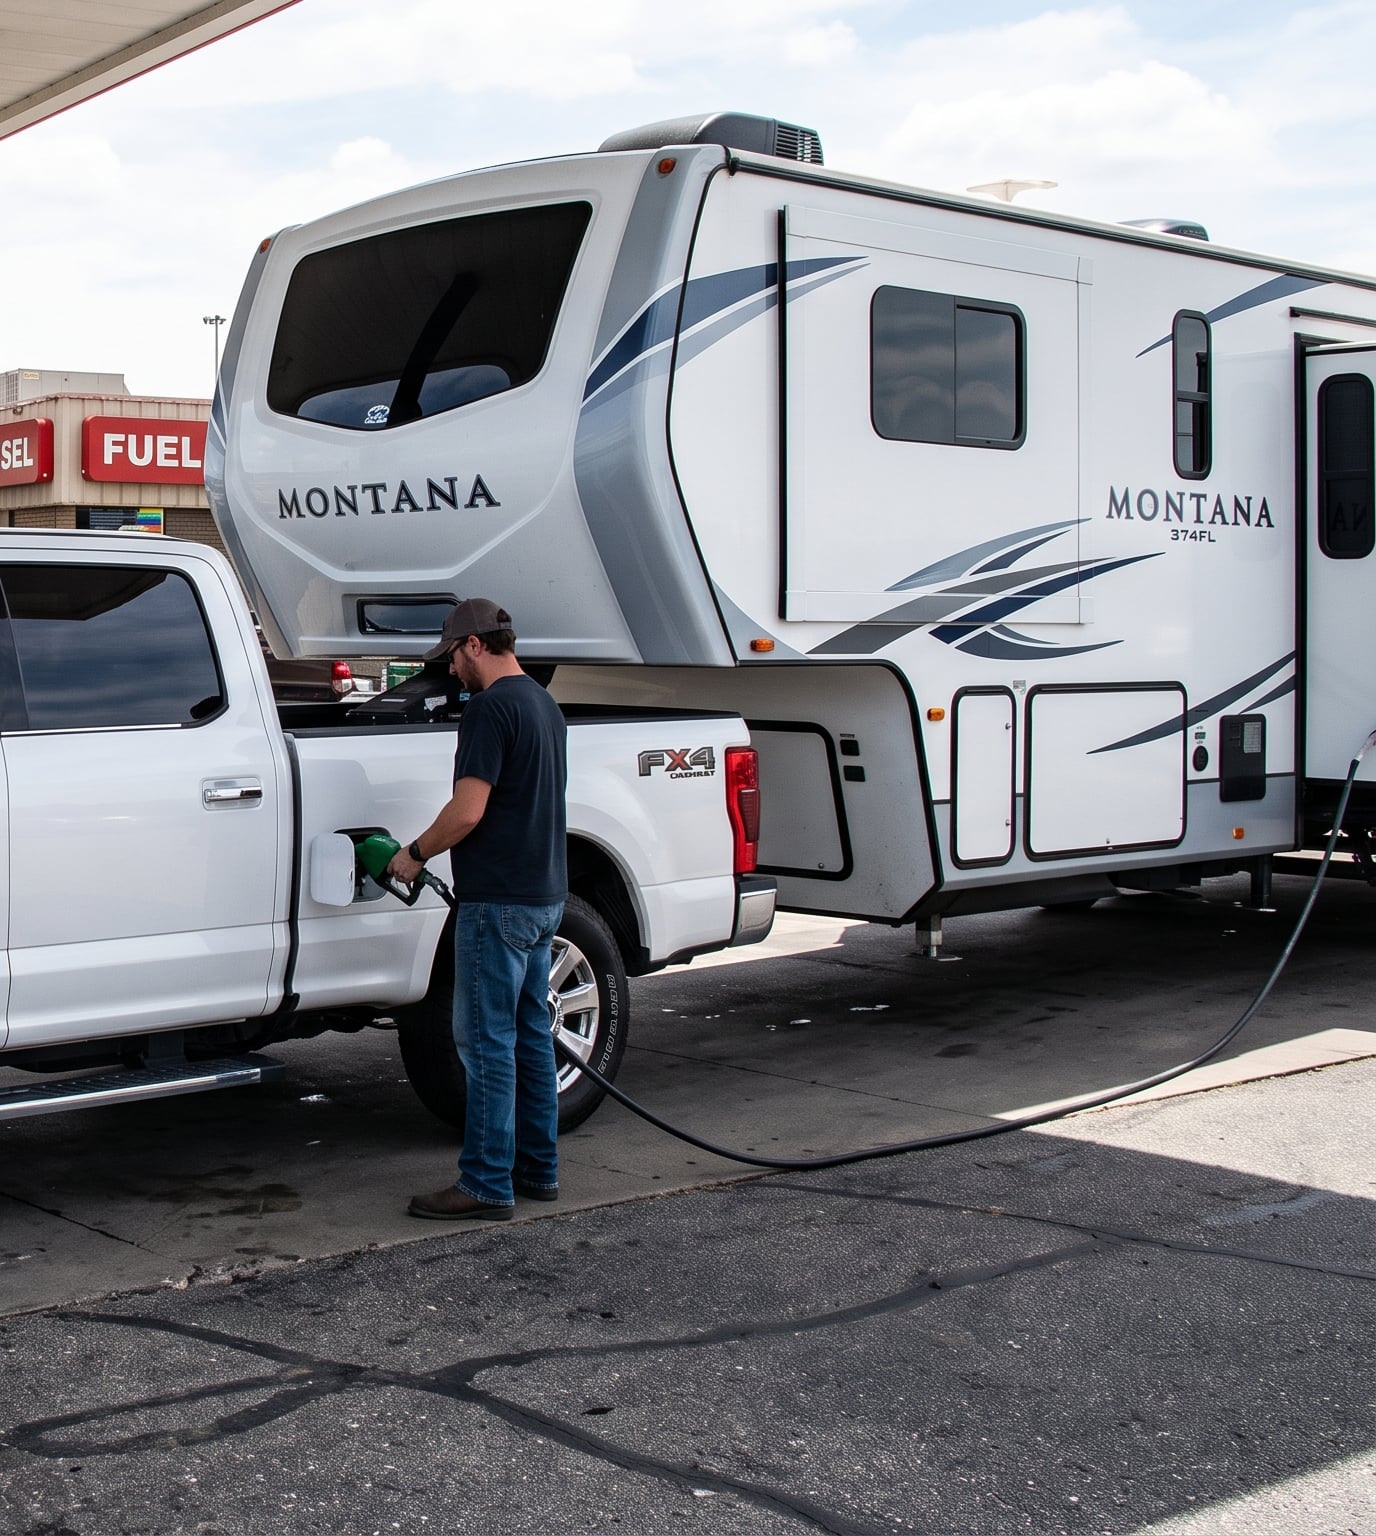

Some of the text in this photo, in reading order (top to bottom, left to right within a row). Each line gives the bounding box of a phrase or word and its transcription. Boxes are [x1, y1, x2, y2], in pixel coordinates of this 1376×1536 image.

[103, 432, 203, 469] FUEL
[278, 473, 502, 520] MONTANA
[1105, 484, 1275, 529] MONTANA
[1170, 529, 1217, 542] 374FL
[637, 746, 716, 777] FX4
